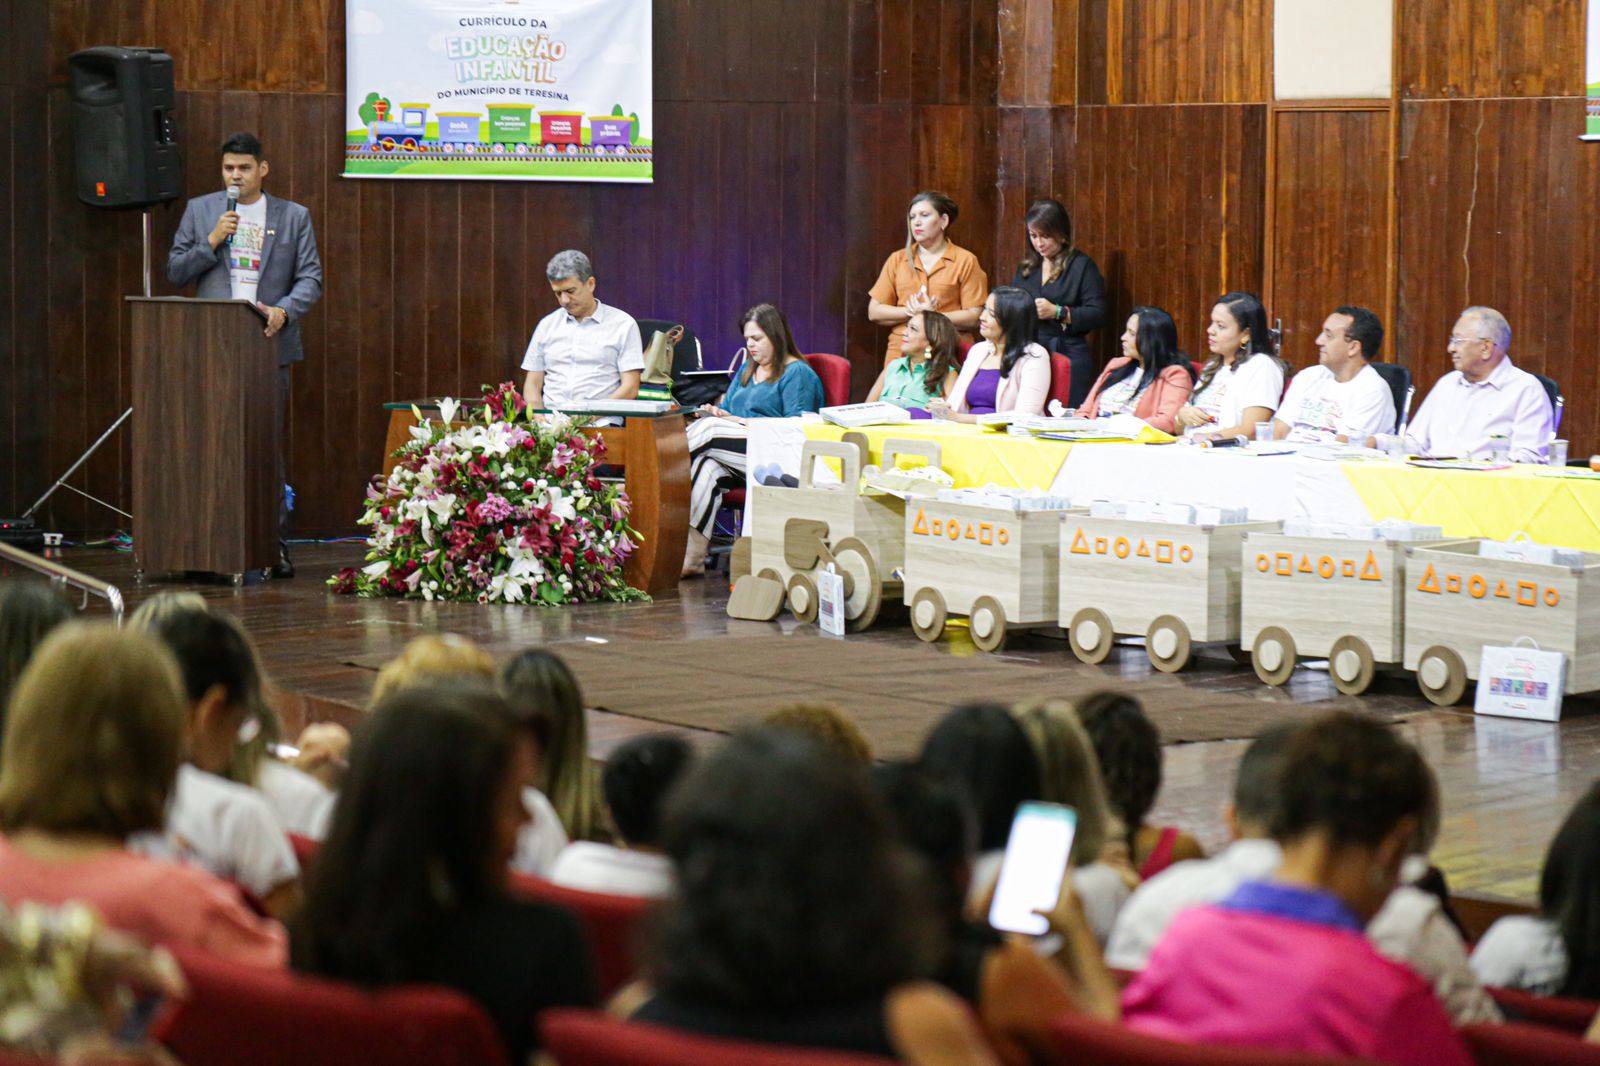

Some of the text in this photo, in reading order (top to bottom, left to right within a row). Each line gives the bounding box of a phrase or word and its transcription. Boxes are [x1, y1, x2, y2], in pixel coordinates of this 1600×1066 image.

[459, 15, 548, 29] CURRÍCULO DA
[445, 33, 567, 62] EDUCAÇÃO
[455, 59, 557, 84] INFANTIL
[437, 85, 569, 101] DO MUNICÍPIO DE TERESINA
